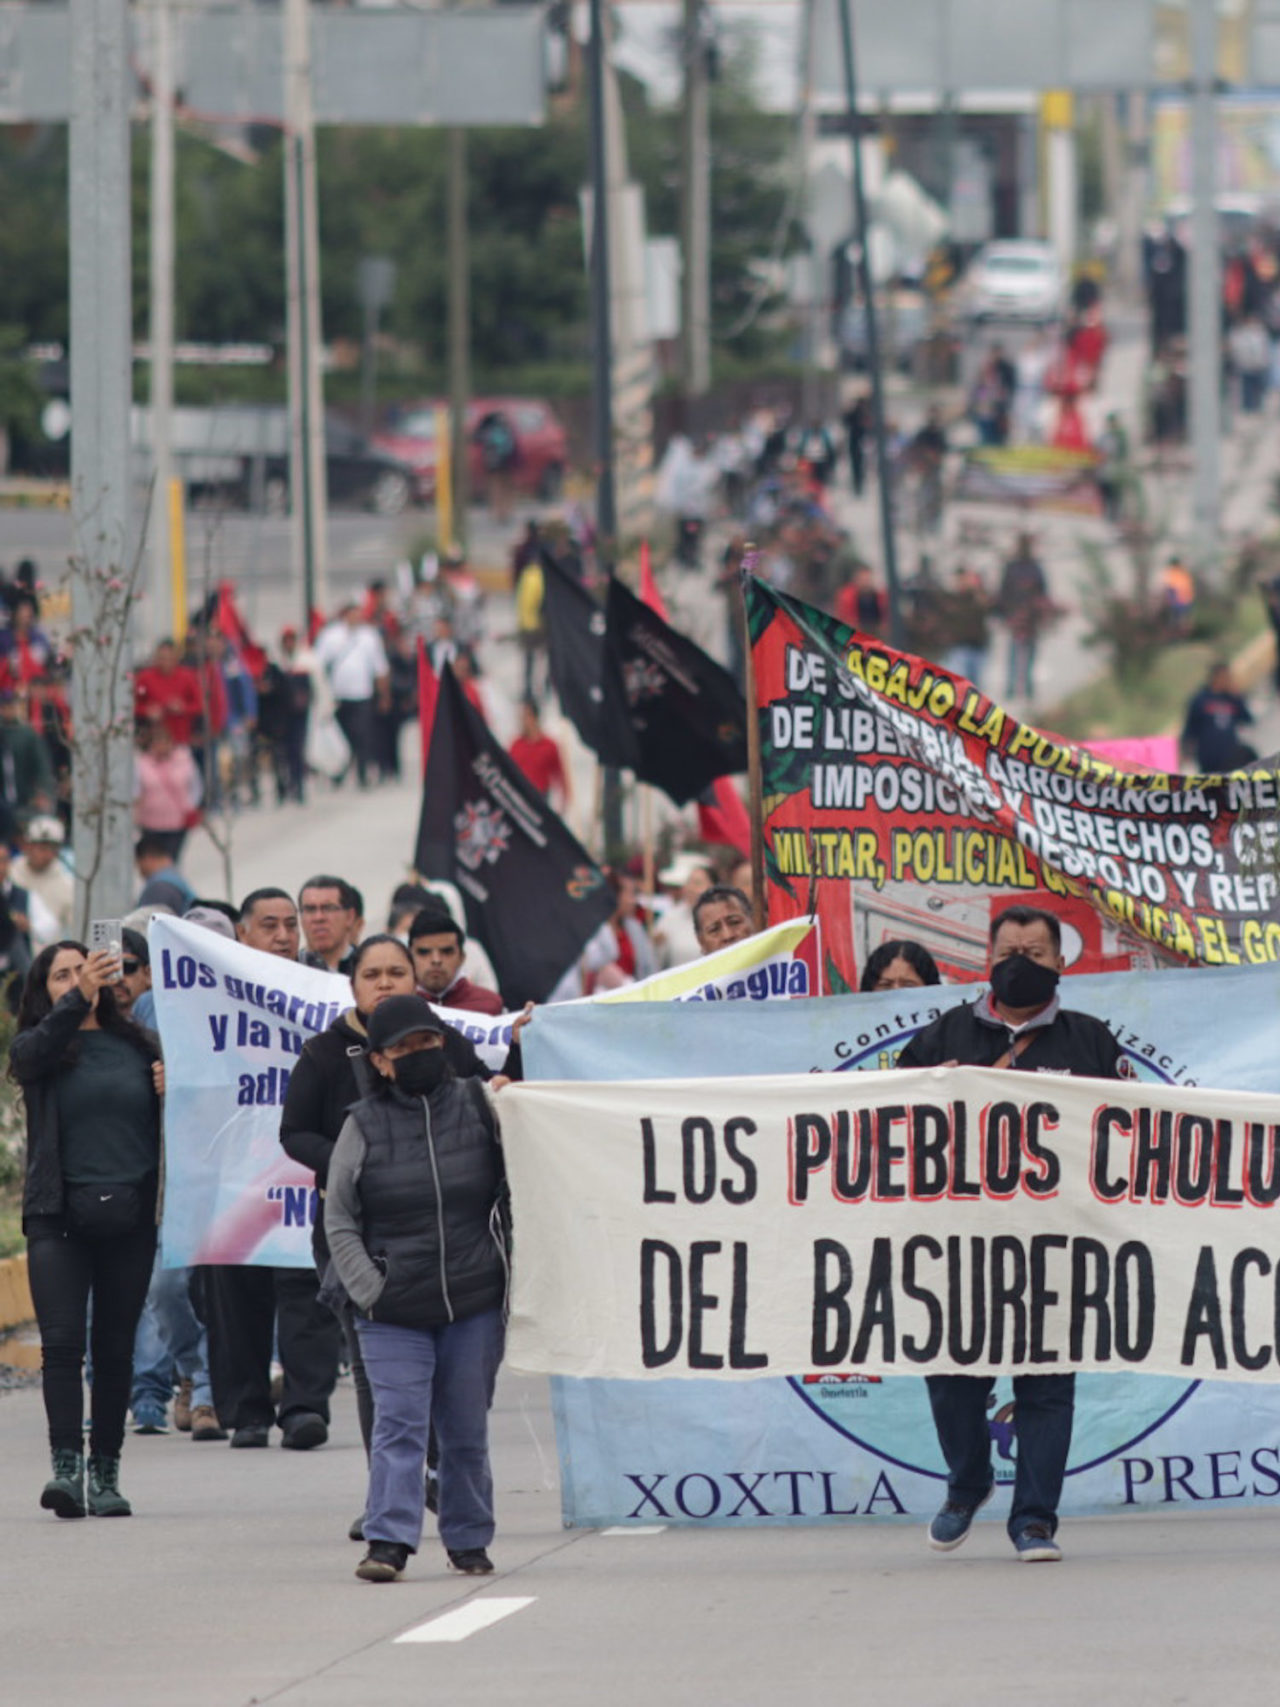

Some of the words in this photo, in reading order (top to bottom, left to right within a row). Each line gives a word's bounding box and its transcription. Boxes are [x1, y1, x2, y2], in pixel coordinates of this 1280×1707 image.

[788, 648, 827, 695] DE
[988, 752, 1218, 820] ARROGANCIA,
[847, 649, 955, 717] ABAJO
[958, 693, 1006, 746] LA
[773, 705, 814, 749] DE
[1002, 788, 1024, 820] Y
[1033, 799, 1226, 873] DERECHOS,
[773, 831, 885, 888] MILITAR,
[895, 831, 1036, 887] POLICIAL
[1196, 916, 1241, 964] EL
[1173, 871, 1198, 908] Y
[162, 949, 217, 989] Los
[209, 1014, 228, 1052] y
[237, 1011, 270, 1048] la
[833, 1007, 942, 1059] Contra
[640, 1116, 757, 1204] LOS
[787, 1101, 1060, 1206] PUEBLOS
[640, 1238, 768, 1369] DEL
[811, 1234, 1155, 1366] BASURERO
[624, 1469, 912, 1519] XOXTLA
